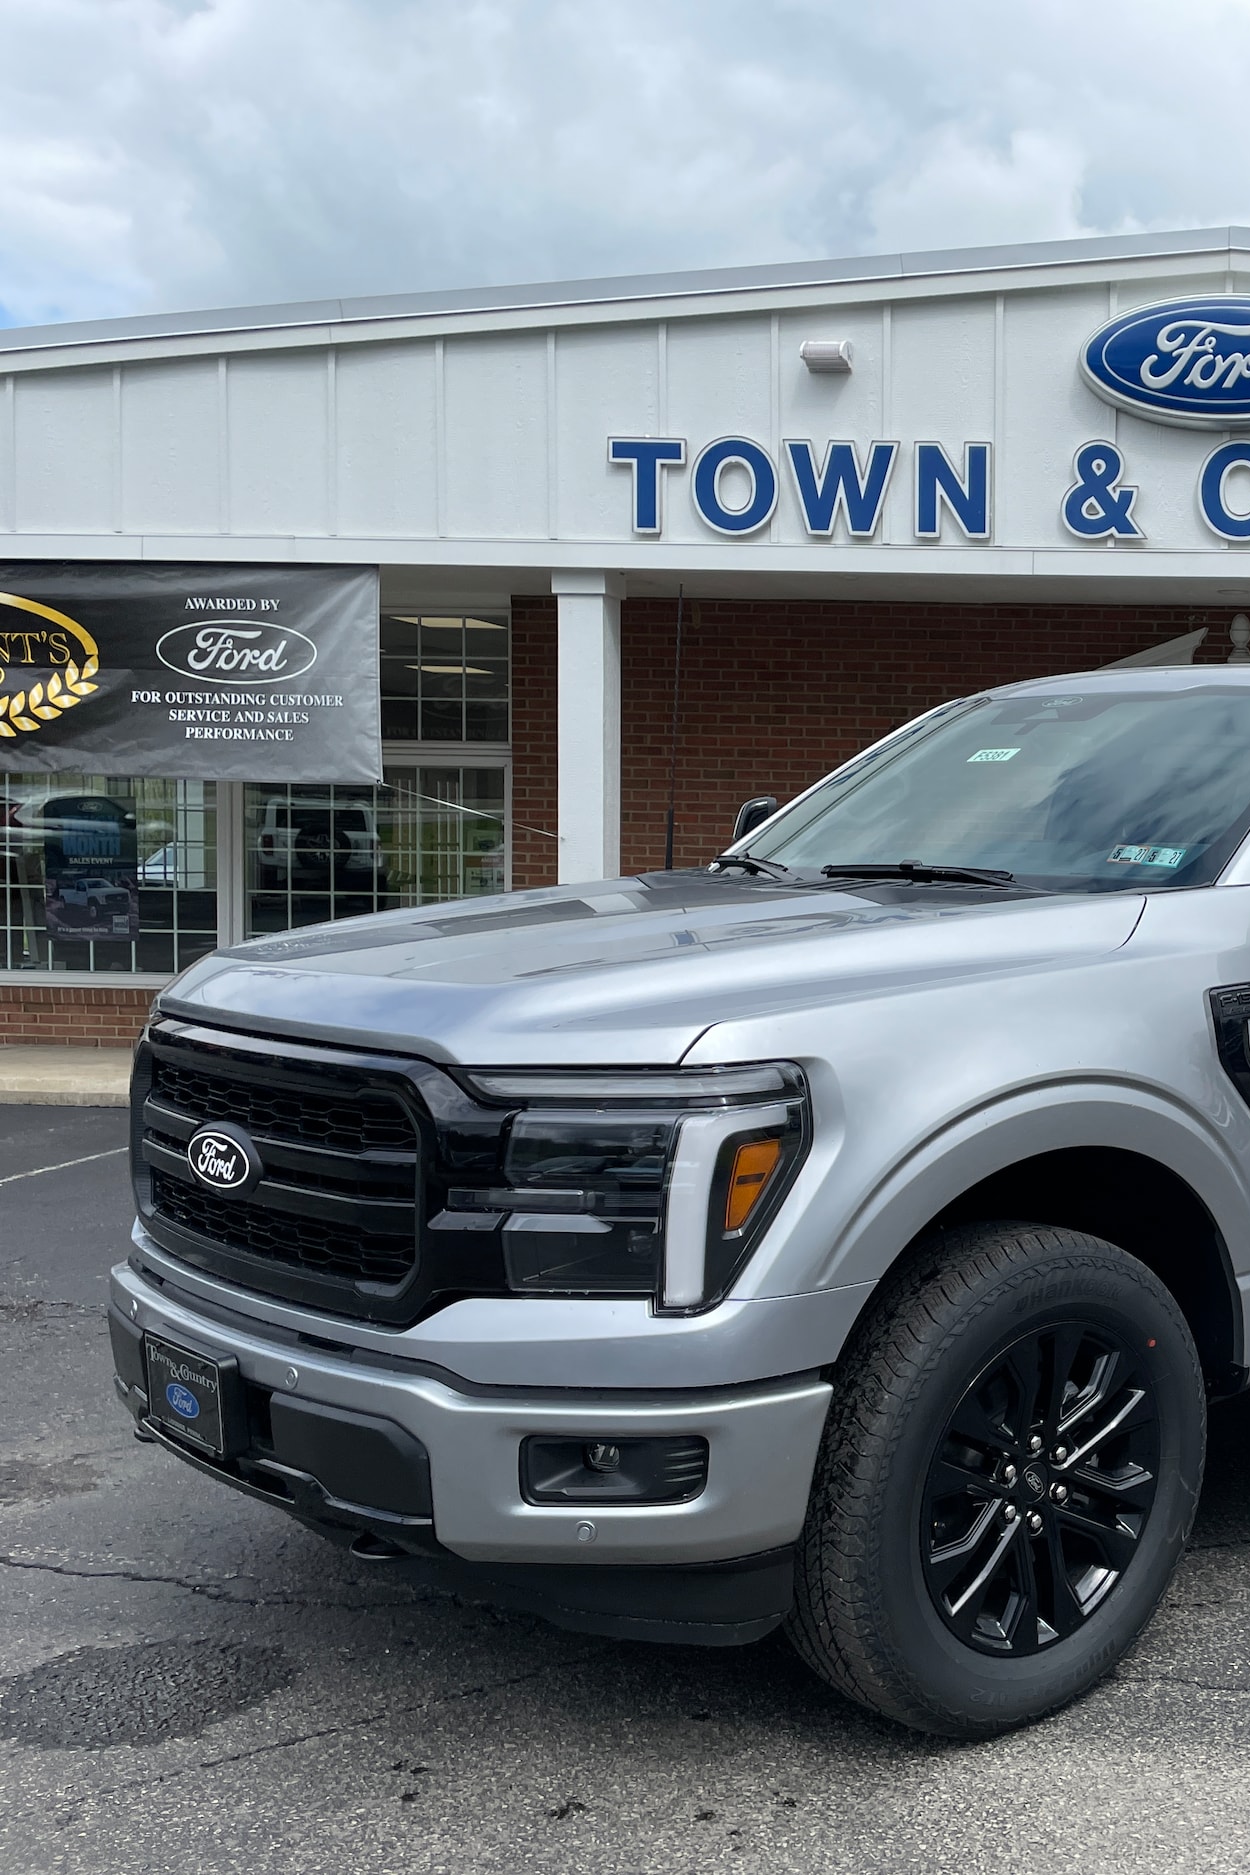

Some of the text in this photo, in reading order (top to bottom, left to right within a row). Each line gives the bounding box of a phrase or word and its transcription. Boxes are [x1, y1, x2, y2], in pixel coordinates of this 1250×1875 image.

[607, 436, 993, 539] TOWN
[1061, 439, 1147, 540] &
[184, 598, 280, 611] AWARDED BY
[187, 628, 288, 671] Ford
[131, 690, 344, 707] FOR OUTSTANDING CUSTOMER
[168, 708, 309, 724] SERVICE AND SALES
[185, 726, 294, 741] PERFORMANCE
[198, 1138, 236, 1181] Ford
[180, 1363, 218, 1393] Country
[172, 1386, 193, 1413] Ford
